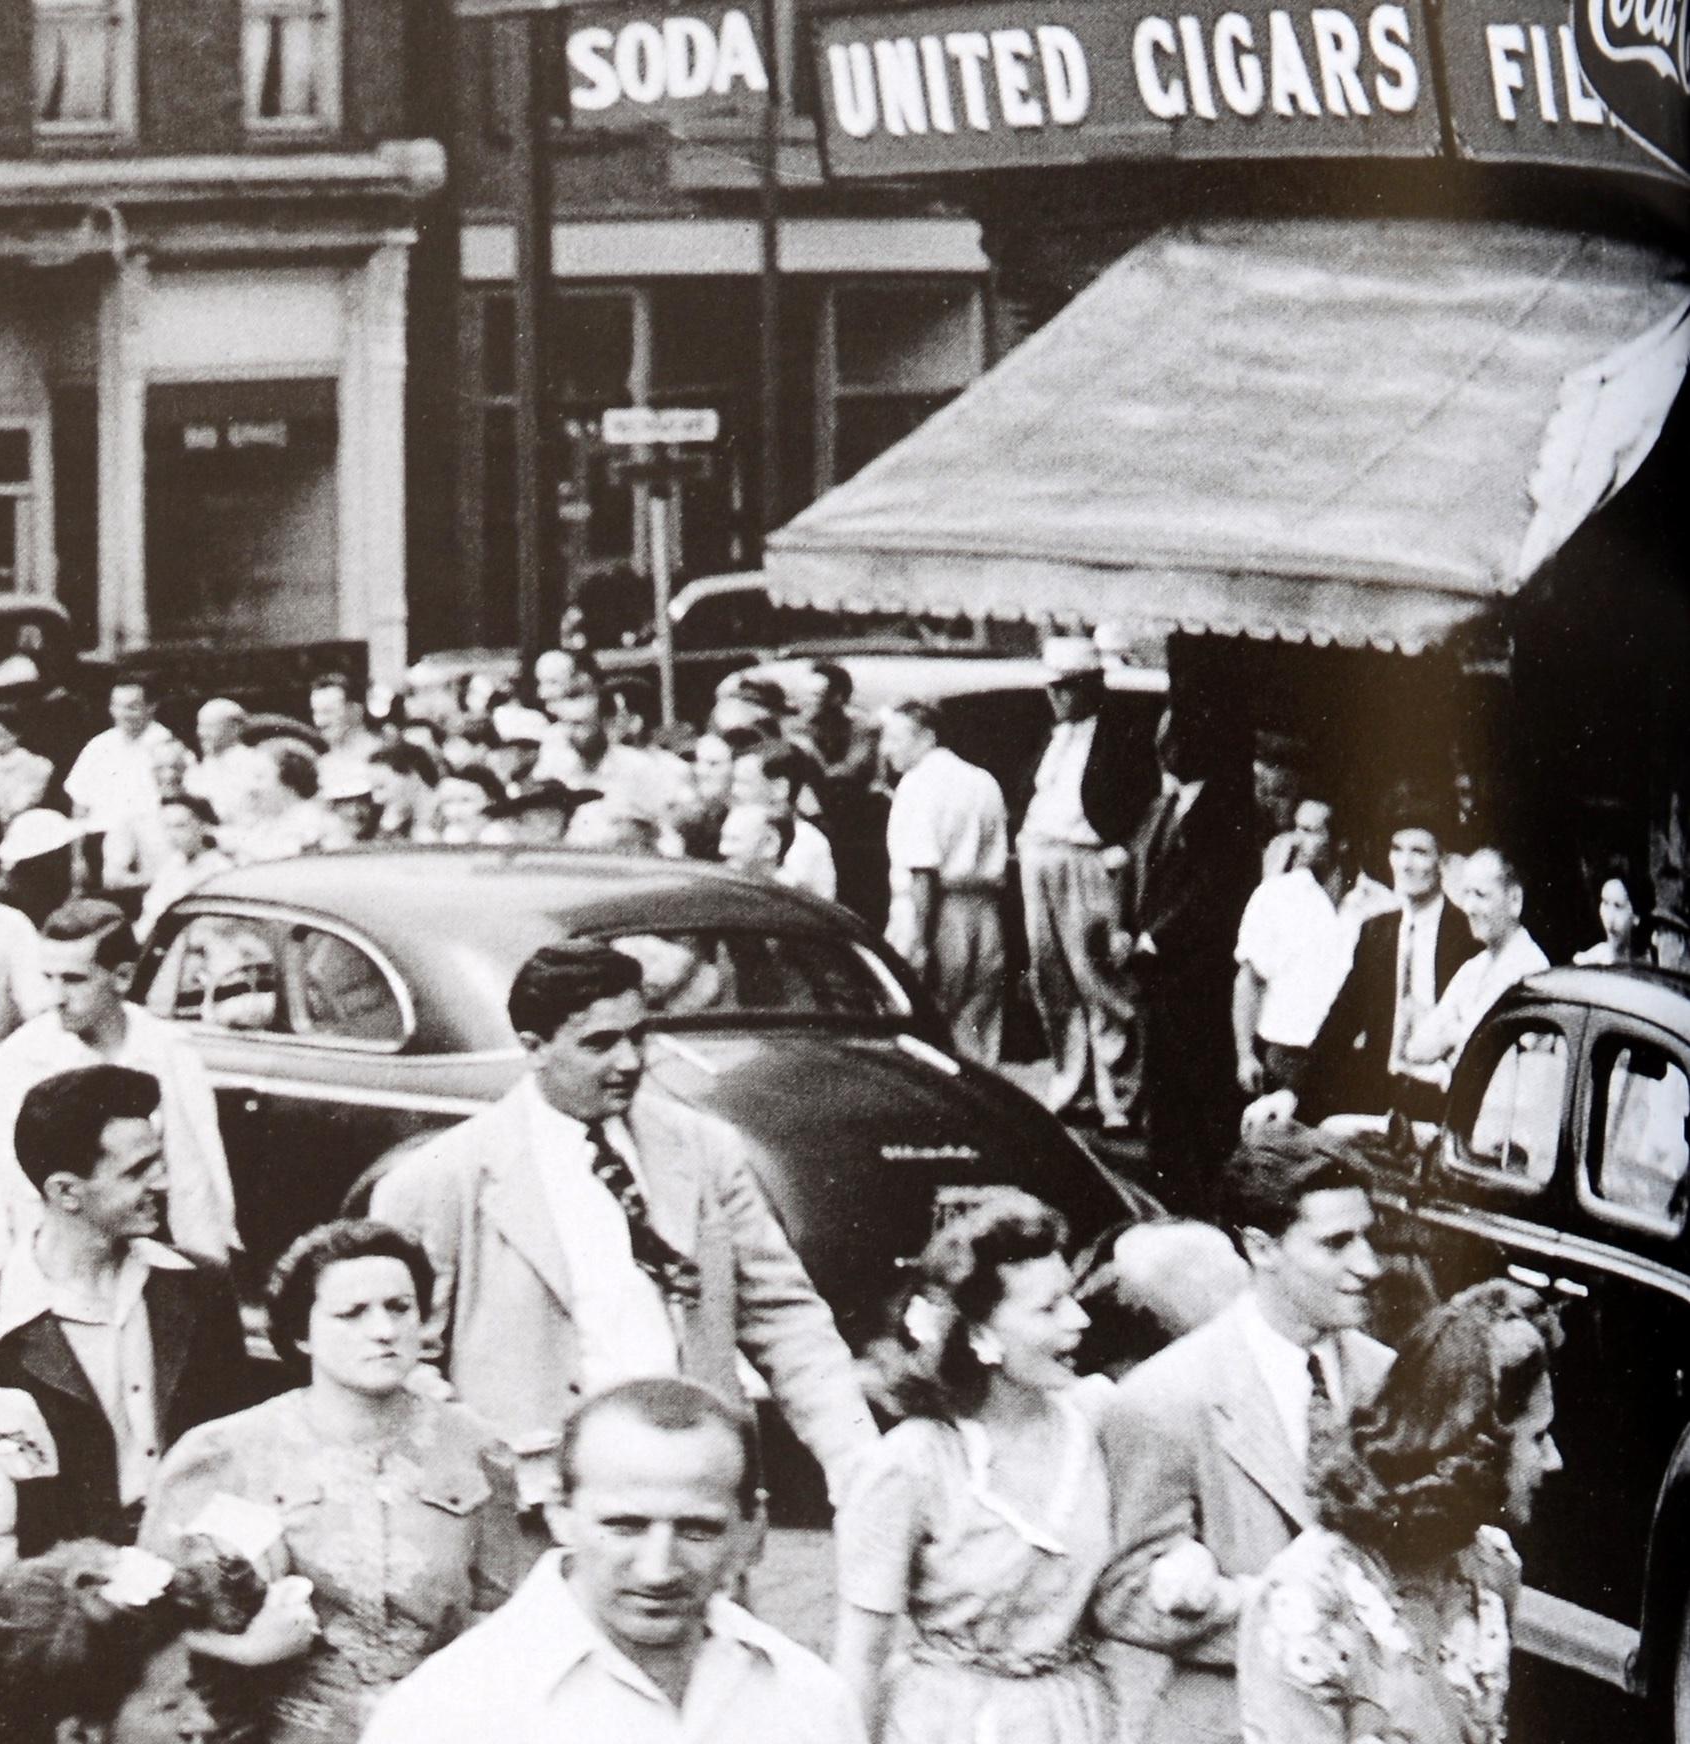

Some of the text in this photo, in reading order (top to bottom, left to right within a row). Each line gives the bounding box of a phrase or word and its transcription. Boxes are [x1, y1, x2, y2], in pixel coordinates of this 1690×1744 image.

[566, 9, 768, 110] SODA
[828, 5, 1419, 138] UNITED CIGARS
[1485, 24, 1618, 128] FIL
